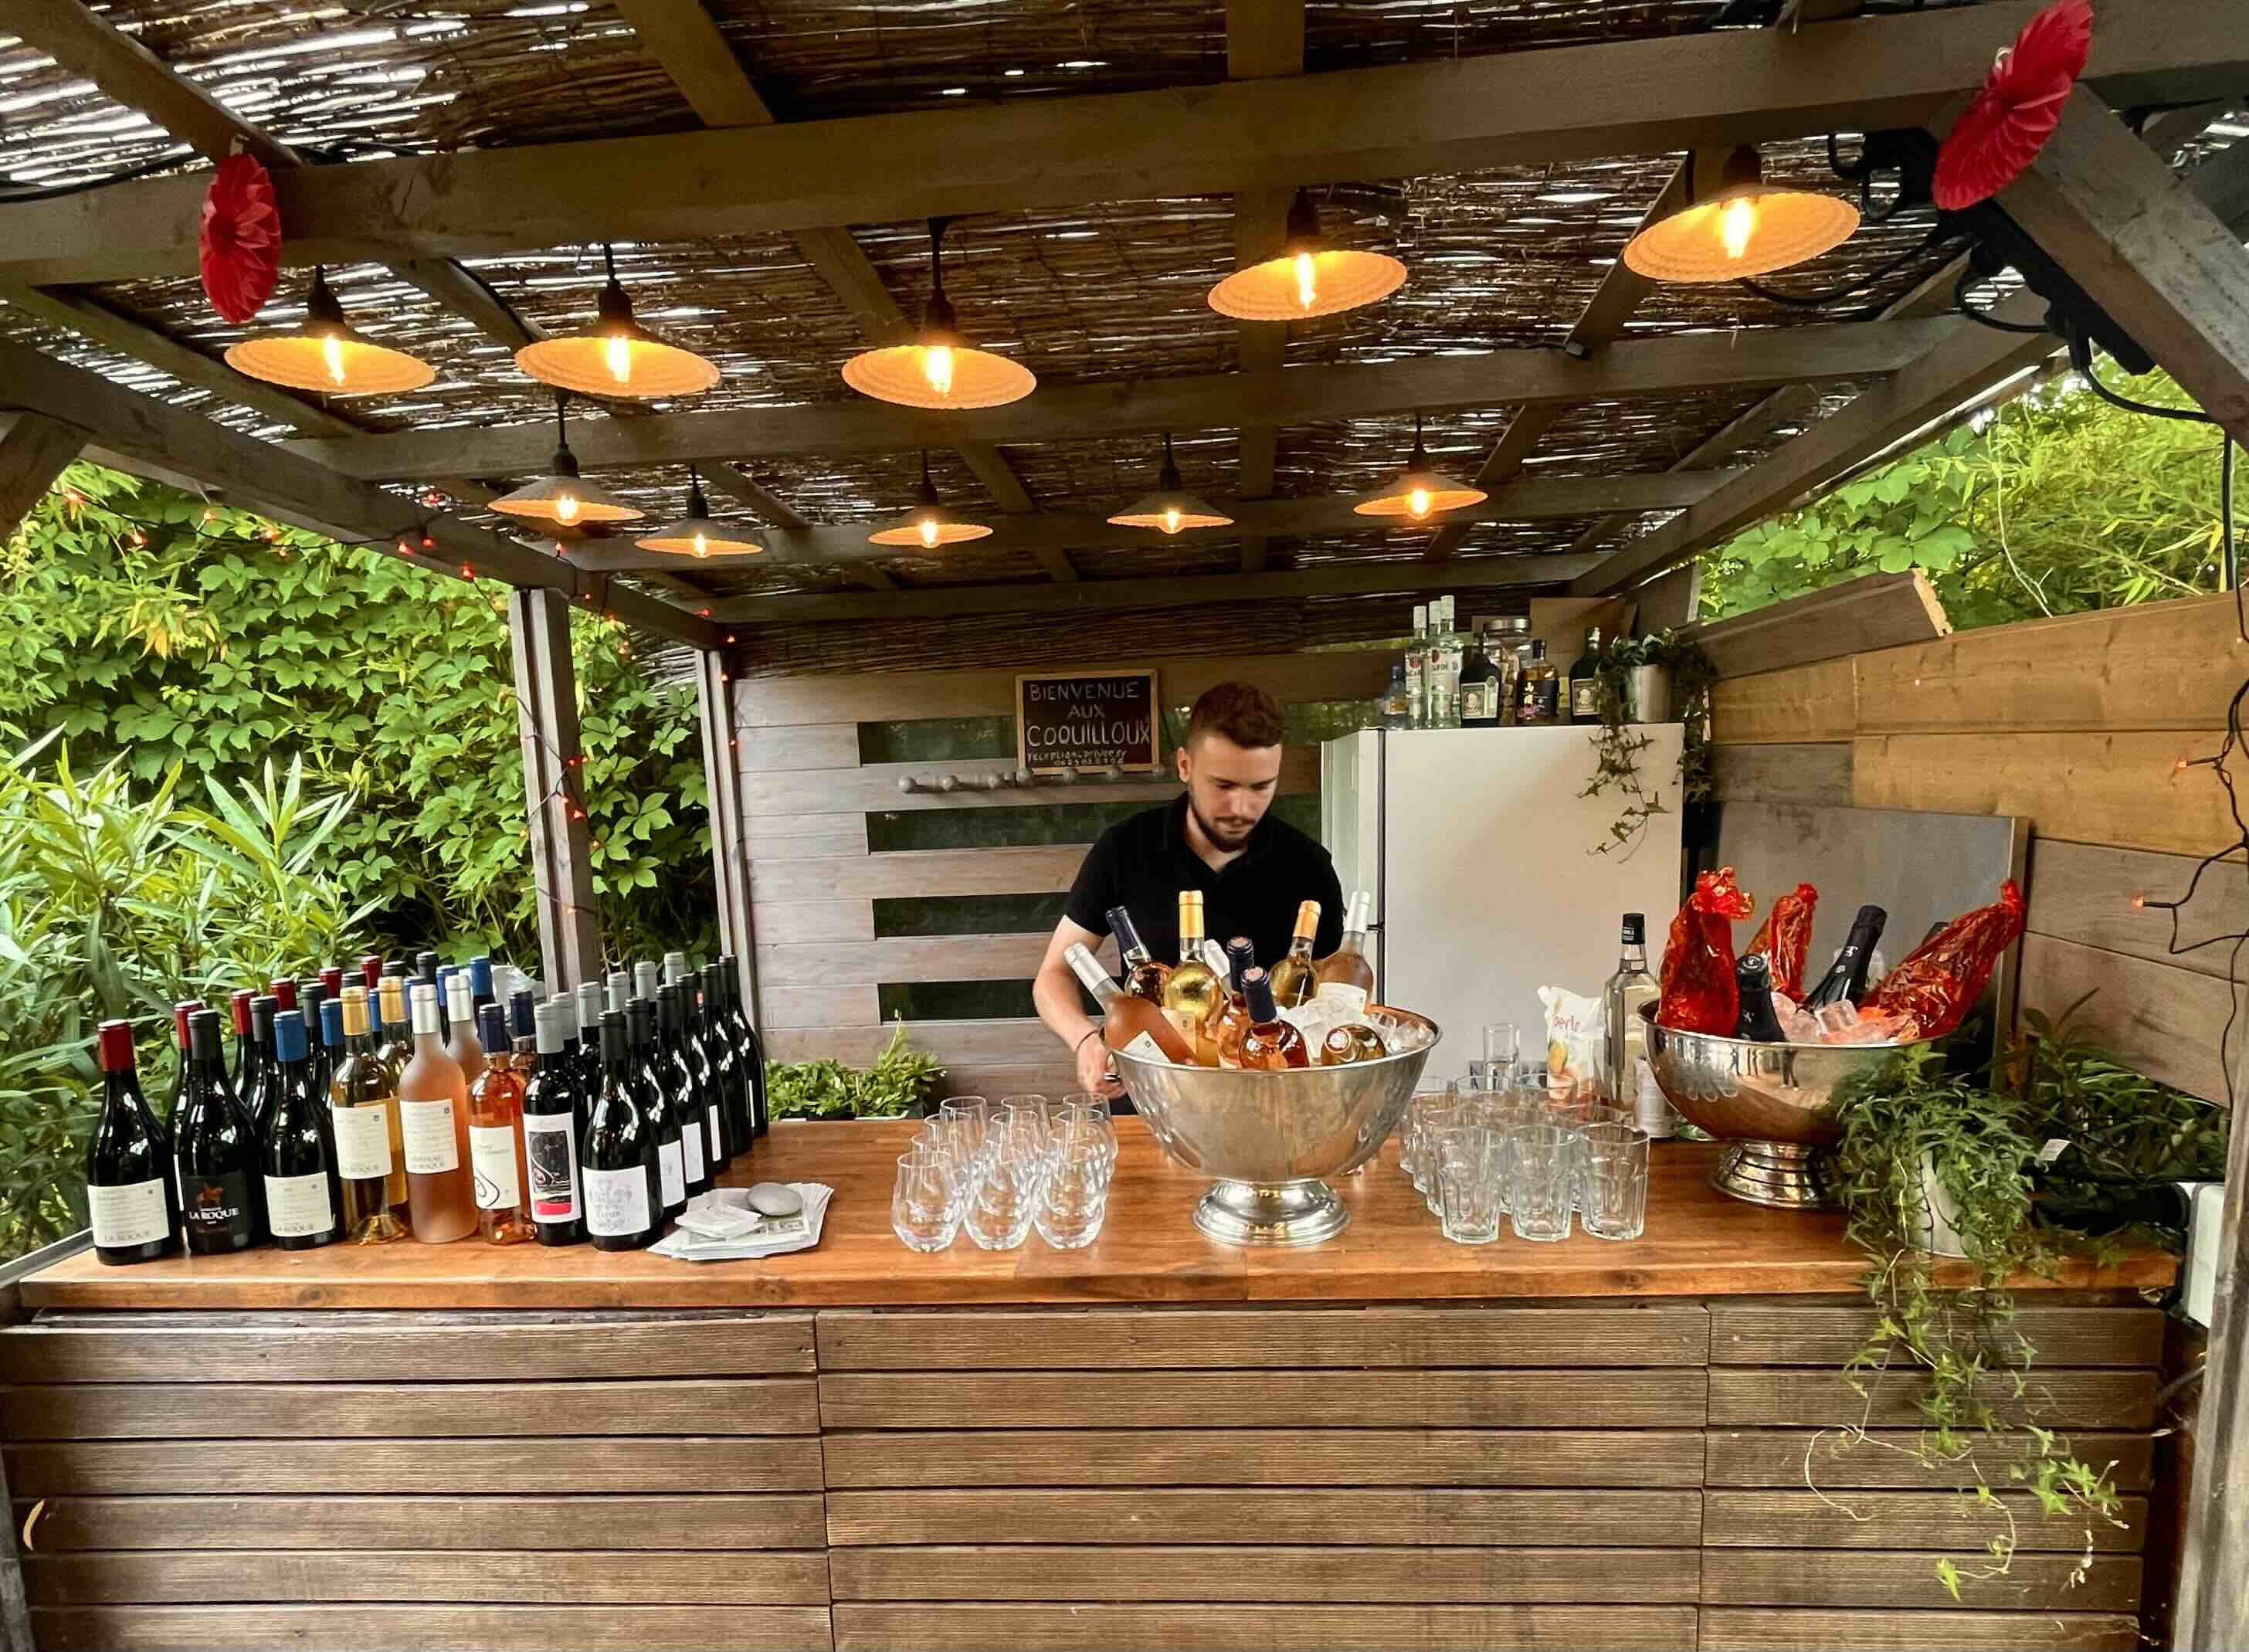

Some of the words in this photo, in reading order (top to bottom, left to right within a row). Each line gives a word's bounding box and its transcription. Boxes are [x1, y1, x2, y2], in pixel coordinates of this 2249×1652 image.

[1030, 682, 1139, 701] BIENVENUE
[1066, 704, 1106, 718] AUX
[1027, 720, 1150, 747] COQUILLOUX
[188, 1210, 200, 1220] LA
[201, 1207, 239, 1219] ROQUE
